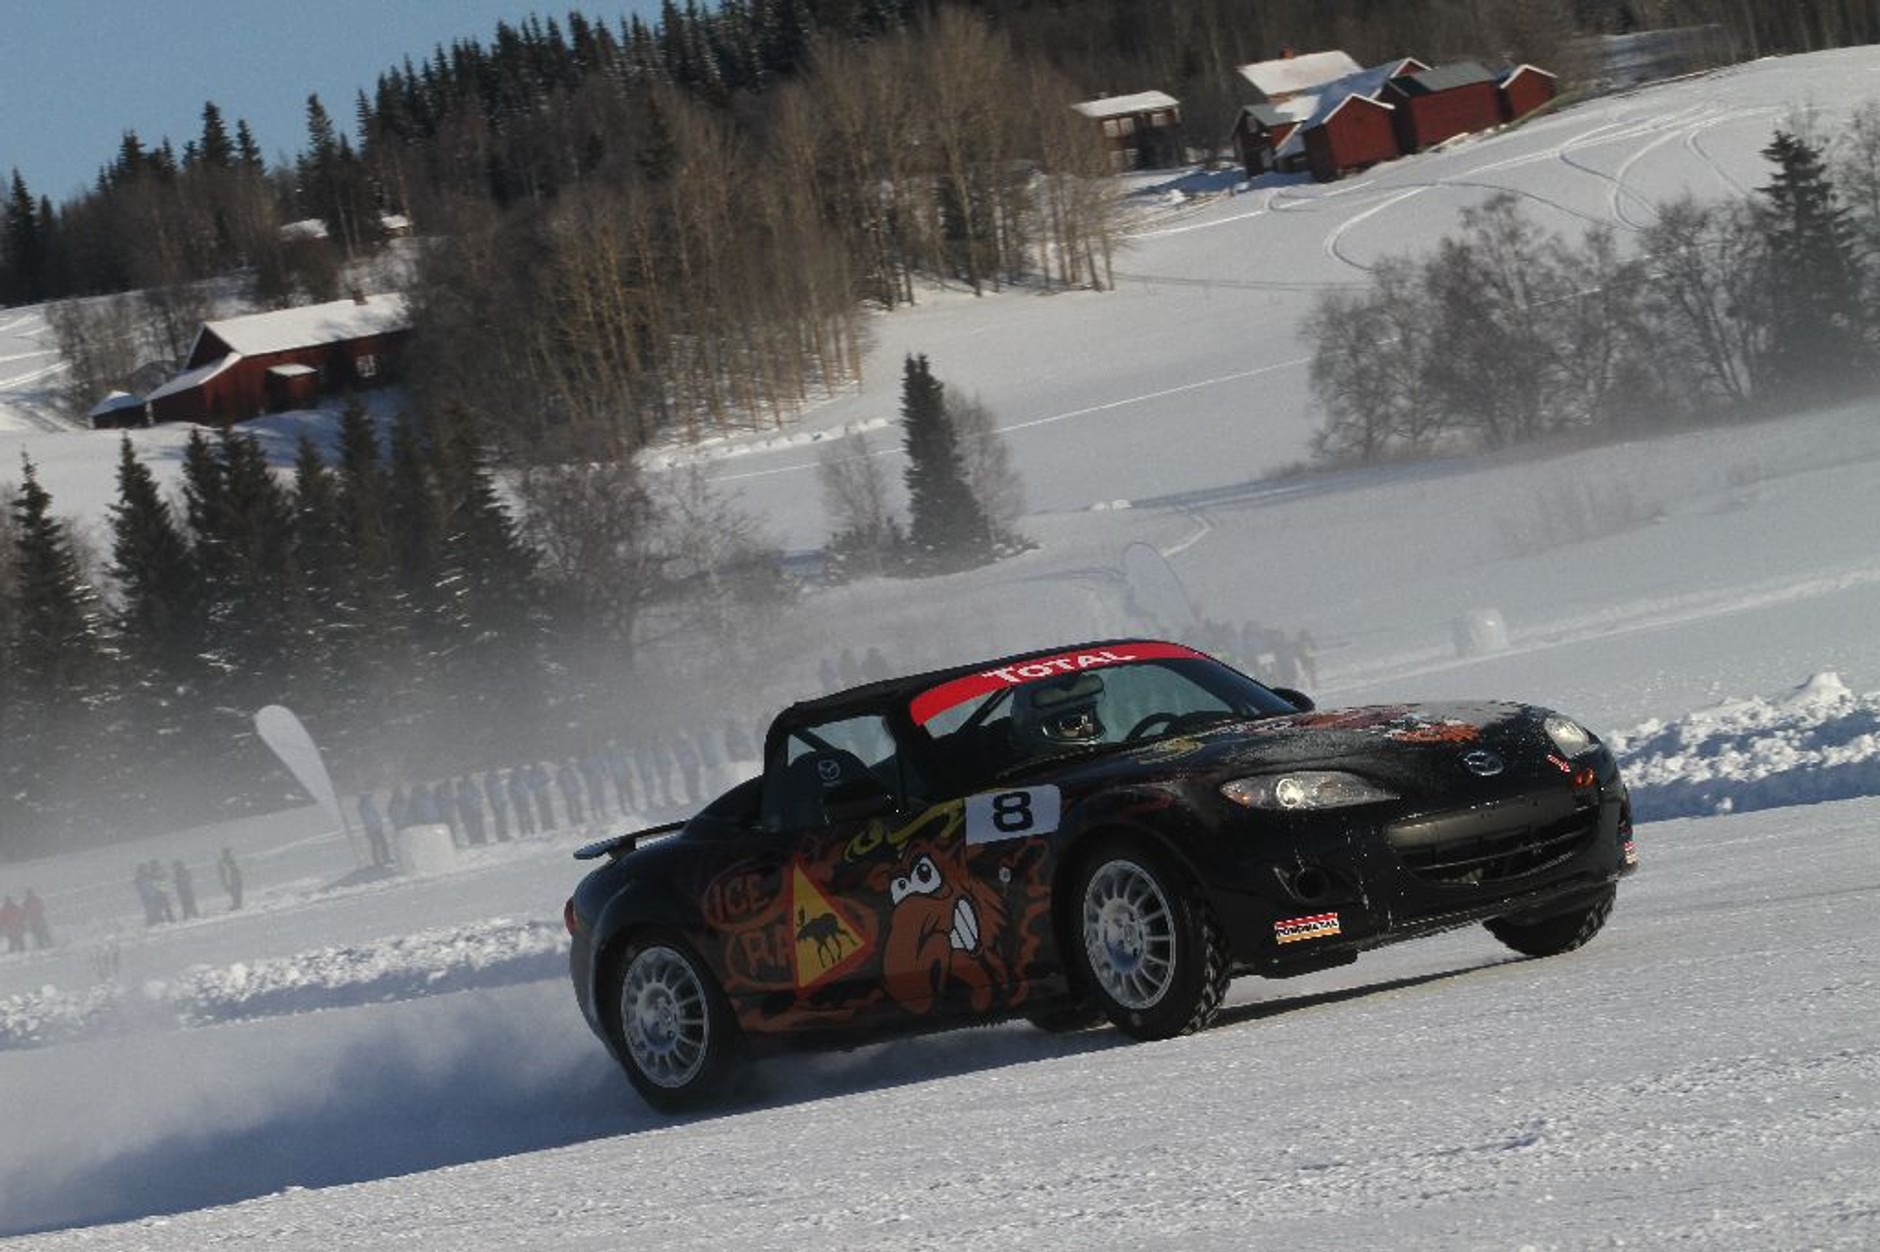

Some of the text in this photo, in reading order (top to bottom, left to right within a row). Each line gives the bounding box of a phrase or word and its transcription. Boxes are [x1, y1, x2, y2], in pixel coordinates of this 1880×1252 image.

[981, 651, 1138, 683] TOTAL
[993, 791, 1034, 832] 8
[712, 871, 770, 923] ICE
